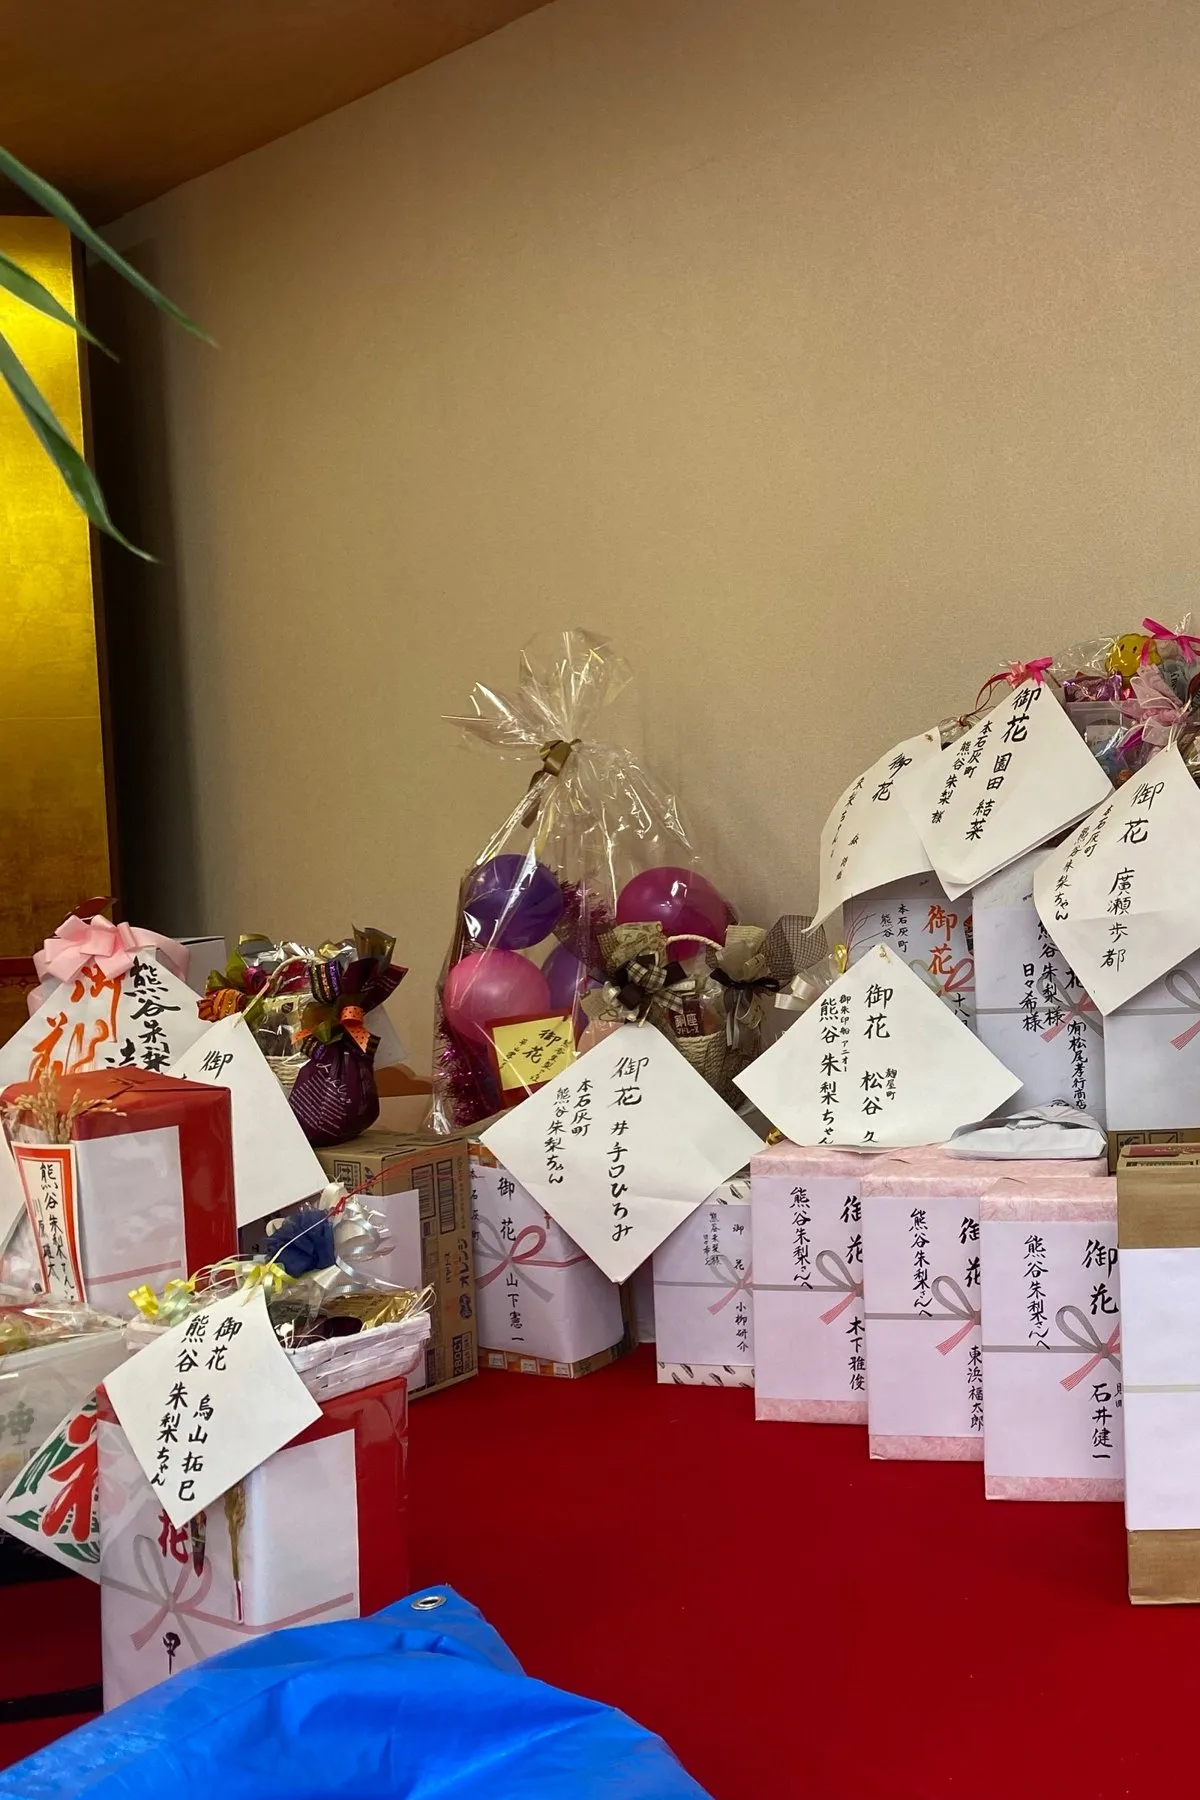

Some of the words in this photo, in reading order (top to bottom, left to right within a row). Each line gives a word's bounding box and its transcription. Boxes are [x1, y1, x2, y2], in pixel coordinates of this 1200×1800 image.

[1001, 686, 1042, 744] 御花
[872, 751, 913, 803] 御花
[963, 719, 993, 779] 本石灰町
[1118, 781, 1165, 845] 御花
[896, 903, 910, 953] 本石灰町
[922, 903, 958, 976] 御花
[123, 955, 183, 1073] 熊谷朱梨
[863, 984, 893, 1040] 御花
[1019, 962, 1046, 1033] 日々希様
[199, 1050, 234, 1079] 御
[523, 1028, 562, 1065] 御花
[570, 1077, 594, 1138] 本石灰町
[606, 1056, 650, 1109] 御花
[544, 1086, 573, 1185] 熊谷朱梨ちゃん
[497, 1175, 517, 1242] 御花
[606, 1120, 634, 1243] 井手口ひろみ
[731, 1223, 745, 1271] 御花
[789, 1186, 814, 1291] 熊谷朱梨さんへ
[908, 1208, 934, 1319] 熊谷朱梨さんへ
[505, 1272, 526, 1343] 山下憲一
[1022, 1234, 1051, 1351] 熊谷朱梨さんへ
[1081, 1239, 1120, 1316] 御花
[203, 1315, 243, 1372] 御花
[150, 1314, 210, 1487] 熊谷朱梨ちゃん
[1089, 1383, 1114, 1460] 石井健一
